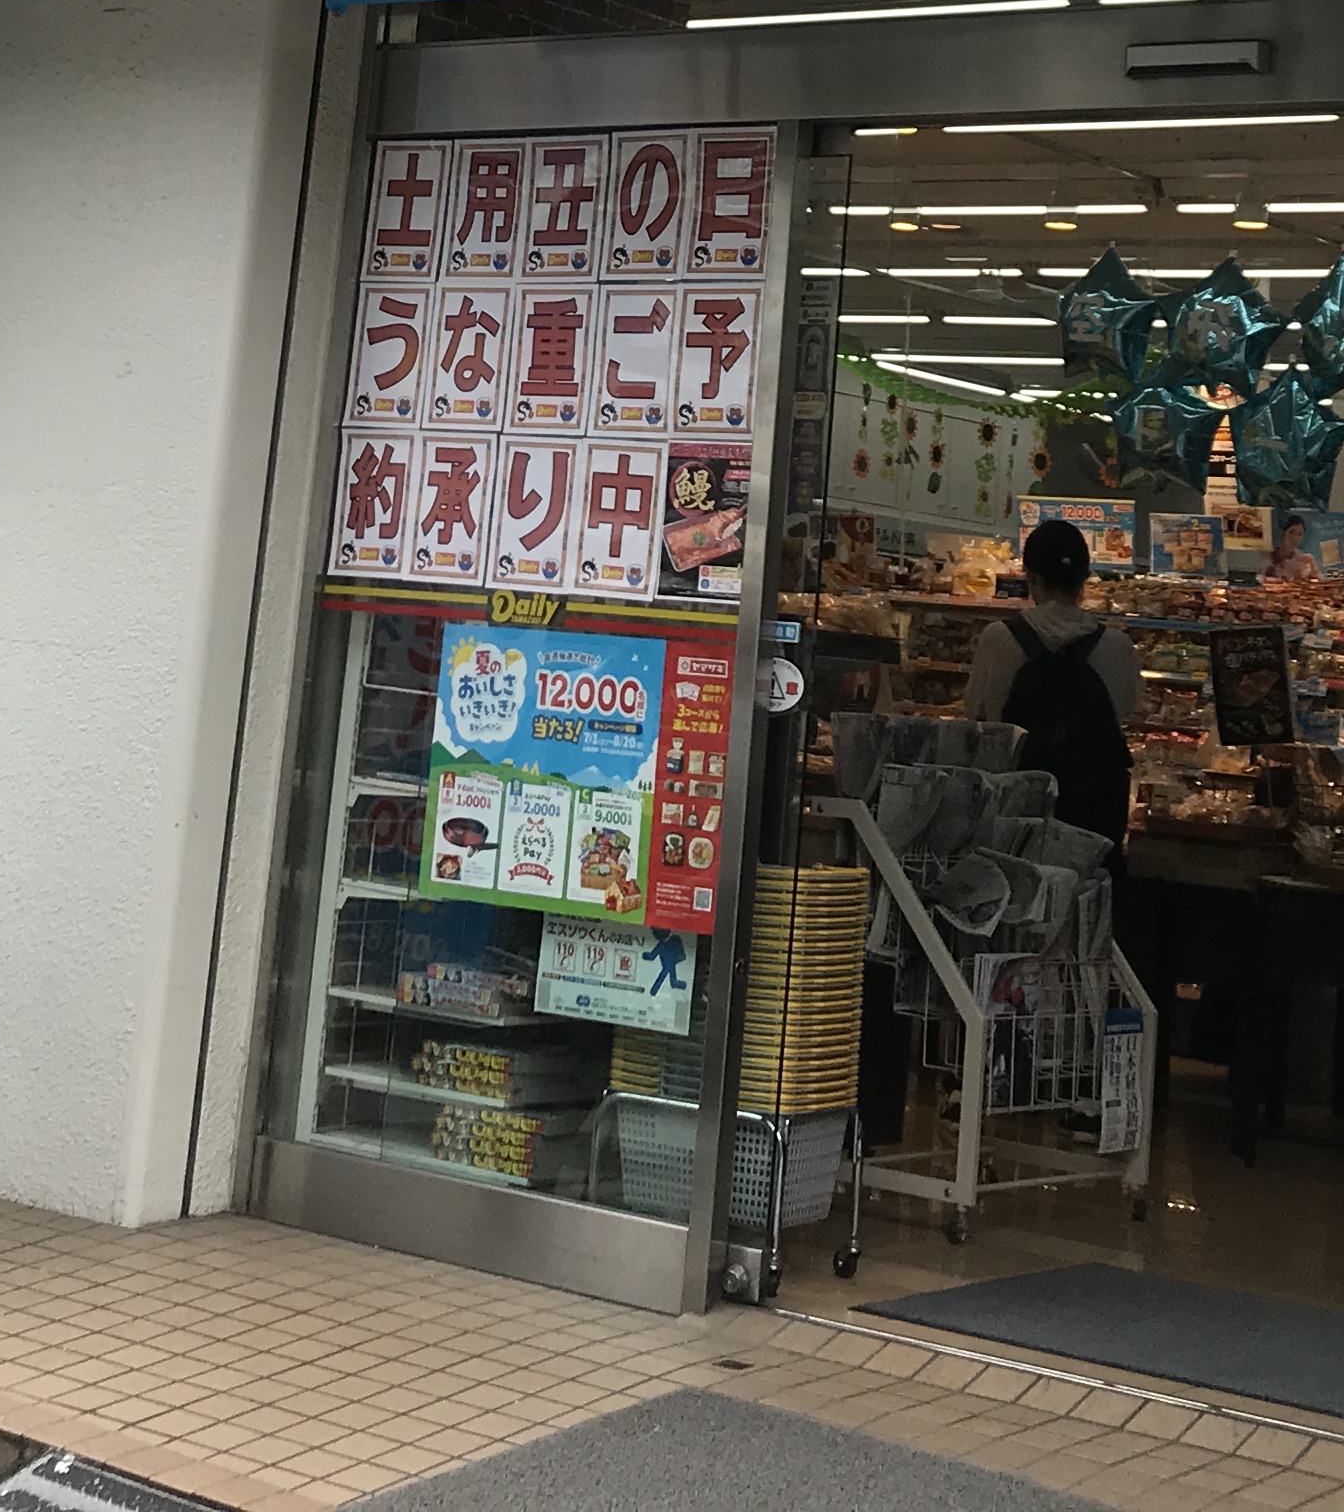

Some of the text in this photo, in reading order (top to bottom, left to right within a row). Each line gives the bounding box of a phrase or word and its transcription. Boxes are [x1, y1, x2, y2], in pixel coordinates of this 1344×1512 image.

[376, 140, 768, 247] 土用丑の日
[366, 294, 752, 401] うな重ご予
[345, 441, 656, 559] 約承り中
[674, 467, 716, 511] 鰻
[491, 589, 560, 625] Daily
[475, 649, 502, 676] 夏の
[457, 673, 516, 700] おいしさ
[535, 670, 639, 716] 12,000
[533, 717, 584, 744] 当たる!
[455, 793, 487, 810] 1,000
[522, 800, 554, 817] 2,000
[594, 809, 628, 826] 9,000
[557, 942, 575, 957] 110
[587, 946, 605, 962] 119
